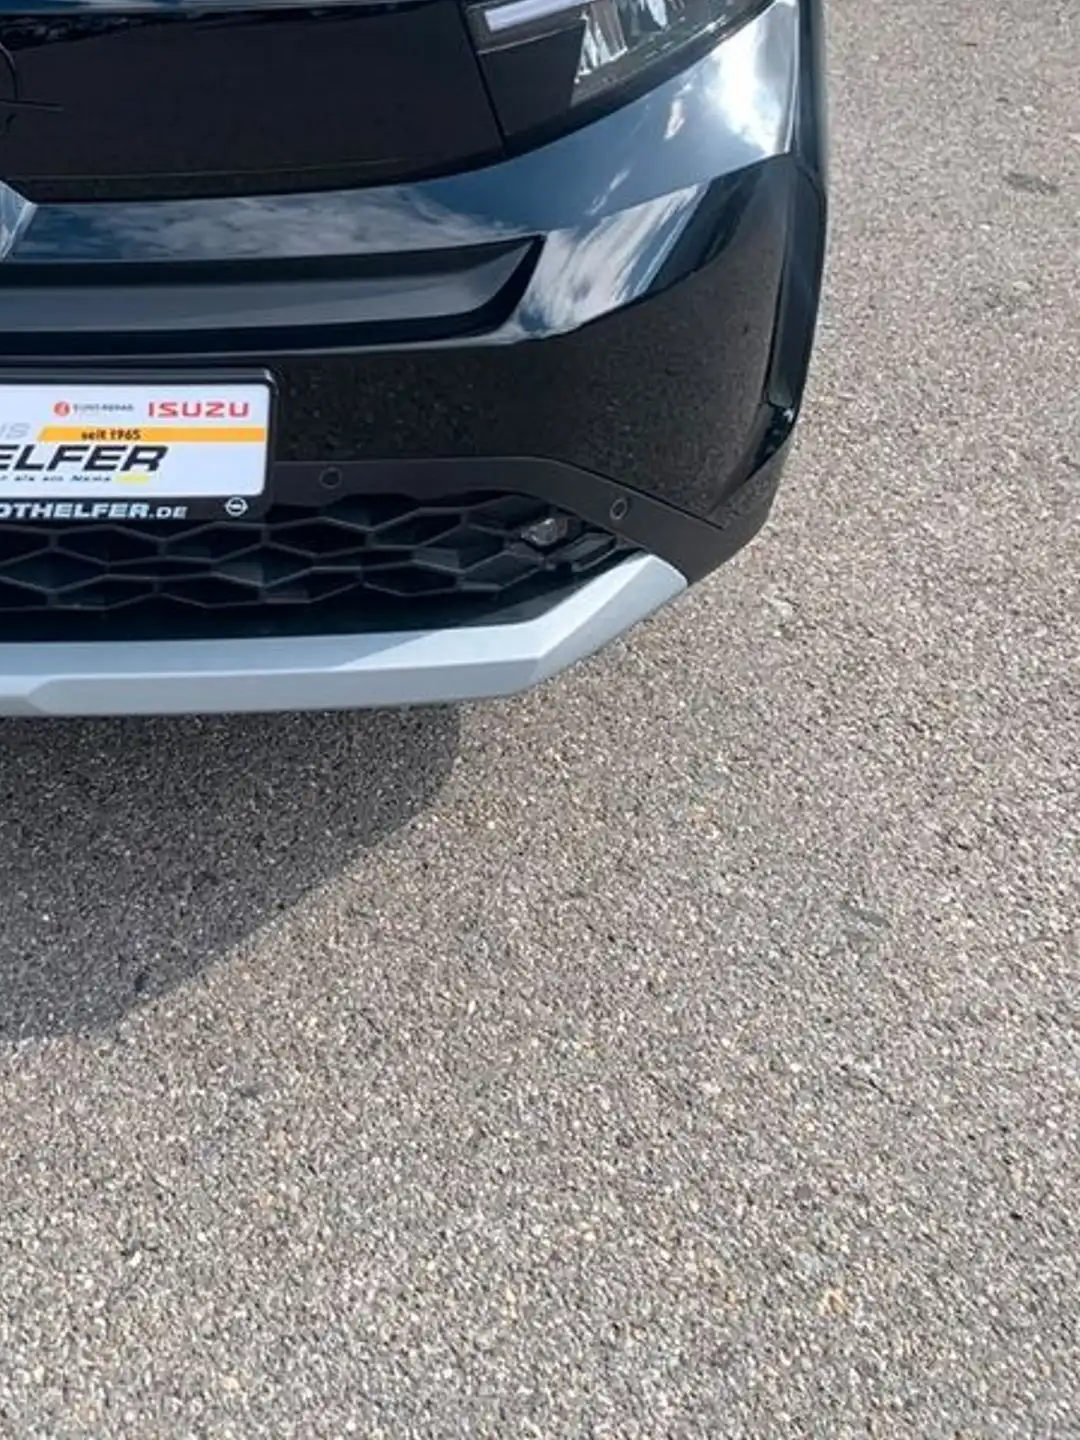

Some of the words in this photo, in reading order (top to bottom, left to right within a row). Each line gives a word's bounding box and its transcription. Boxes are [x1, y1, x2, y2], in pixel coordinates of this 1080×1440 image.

[148, 401, 250, 418] ISUZU
[81, 428, 107, 440] seit
[110, 427, 142, 441] 1965
